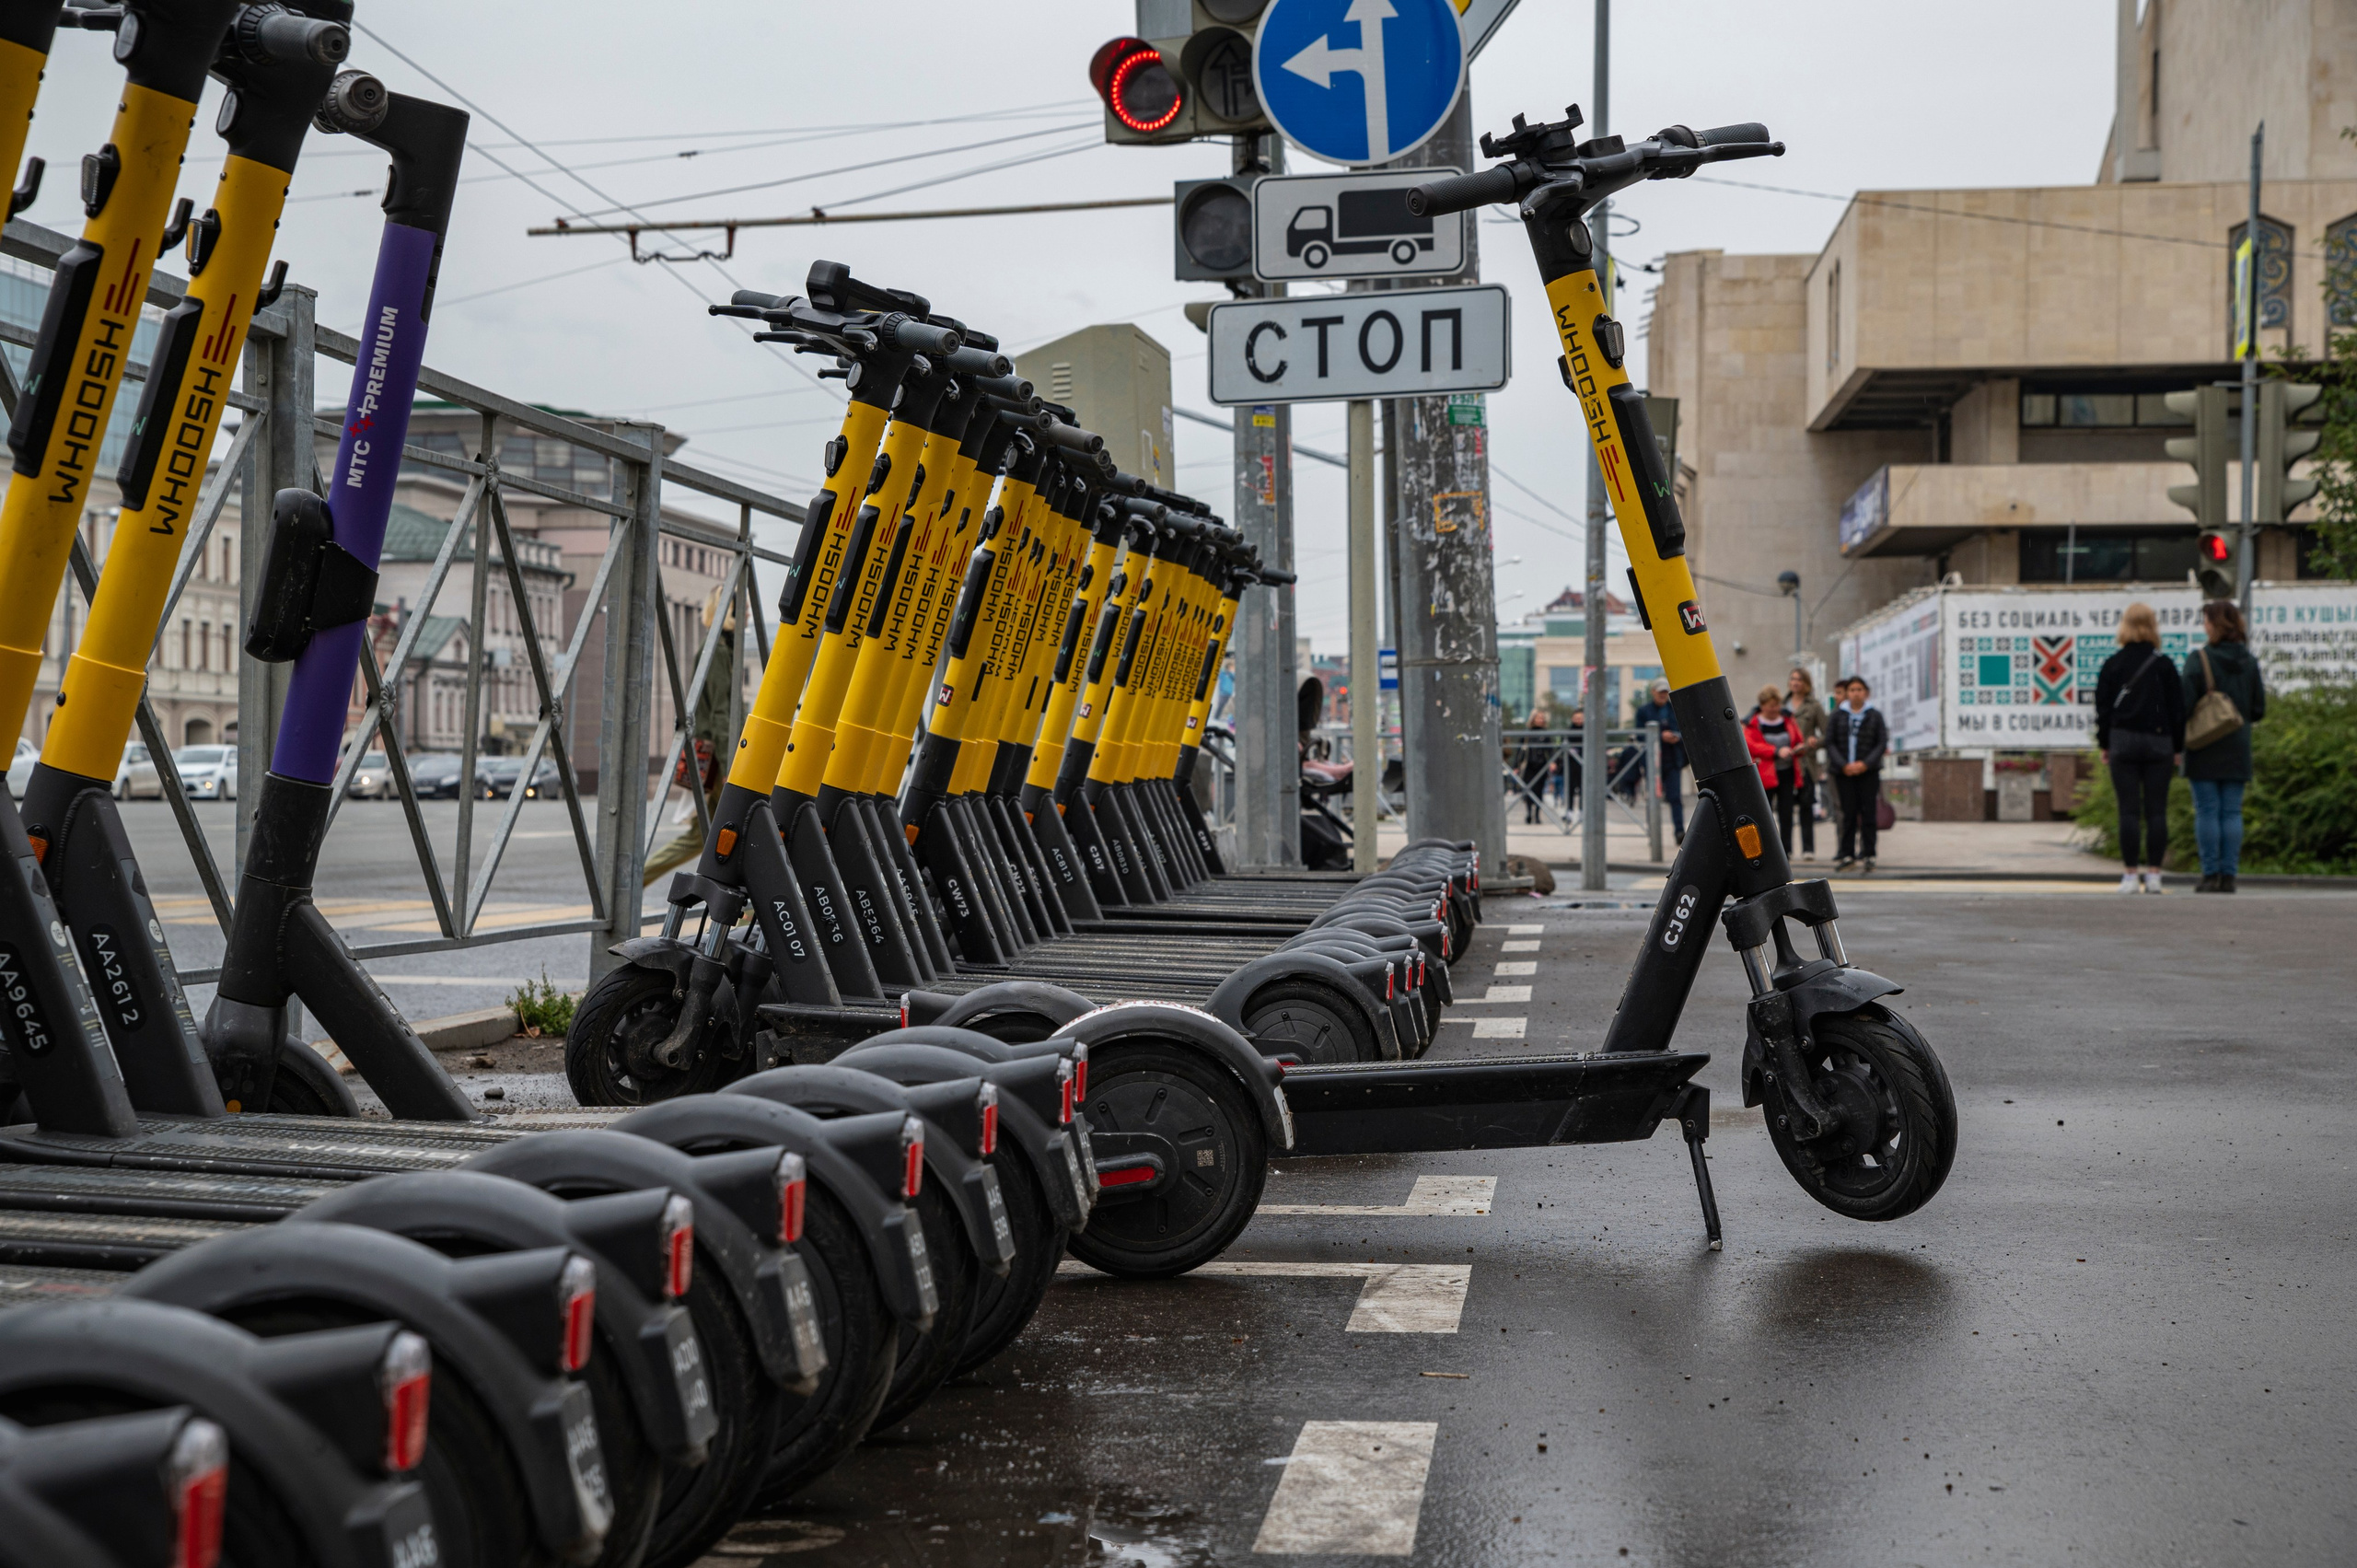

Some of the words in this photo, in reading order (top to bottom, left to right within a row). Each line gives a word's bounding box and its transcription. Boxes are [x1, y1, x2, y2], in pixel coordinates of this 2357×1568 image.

[1246, 308, 1462, 383] СТОП
[1556, 304, 1611, 444] WHOOSH
[48, 318, 125, 504] WHOOSH
[149, 366, 222, 535] WHOOSH
[800, 531, 846, 639] WHOOSH
[846, 546, 888, 648] WHOOSH
[884, 553, 923, 651] WHOOSH
[902, 566, 940, 660] WHOOSH
[982, 537, 1016, 622] WHOOSH
[1035, 566, 1065, 642] WHOOSH
[1049, 573, 1076, 647] WHOOSH
[922, 577, 959, 667] WHOOSH
[984, 592, 1016, 675] WHOOSH
[1004, 600, 1034, 680] WHOOSH
[1069, 624, 1095, 692] WHOOSH
[1112, 595, 1137, 658] WHOOSH
[1958, 610, 1991, 629] БЕЗ
[1998, 610, 2083, 630] СОЦИАЛЬ
[1128, 633, 1153, 696] WHOOSH
[1958, 714, 1987, 731] МЫ
[1993, 714, 2003, 730] В
[946, 878, 970, 919] CW73
[1051, 847, 1074, 883] AC8121
[772, 900, 806, 958] AC0107
[1664, 894, 1697, 946] CJ62
[0, 953, 49, 1051] AA9645
[92, 933, 139, 1025] AA2612
